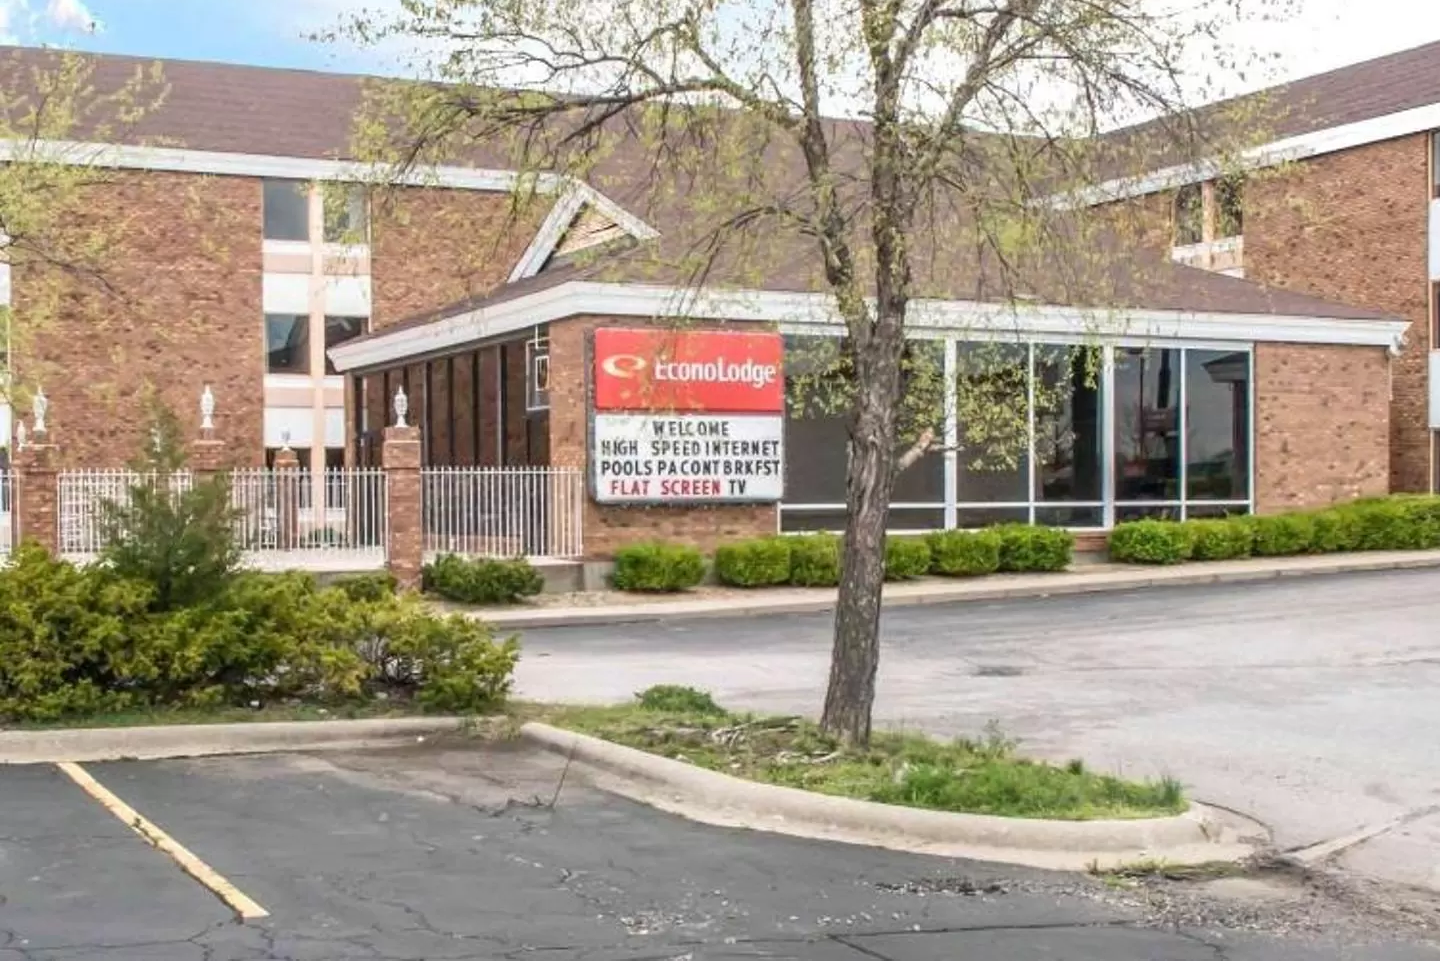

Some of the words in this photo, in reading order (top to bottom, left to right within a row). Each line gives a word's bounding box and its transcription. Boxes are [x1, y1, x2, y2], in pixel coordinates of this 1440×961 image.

[655, 356, 776, 388] EconoLodge
[652, 421, 729, 437] WELCOME
[602, 441, 638, 456] HIGH
[651, 441, 699, 456] SPEED
[705, 441, 779, 457] INTERNET
[611, 480, 650, 495] FLAT
[661, 480, 721, 495] SCREEN
[728, 480, 747, 495] TV
